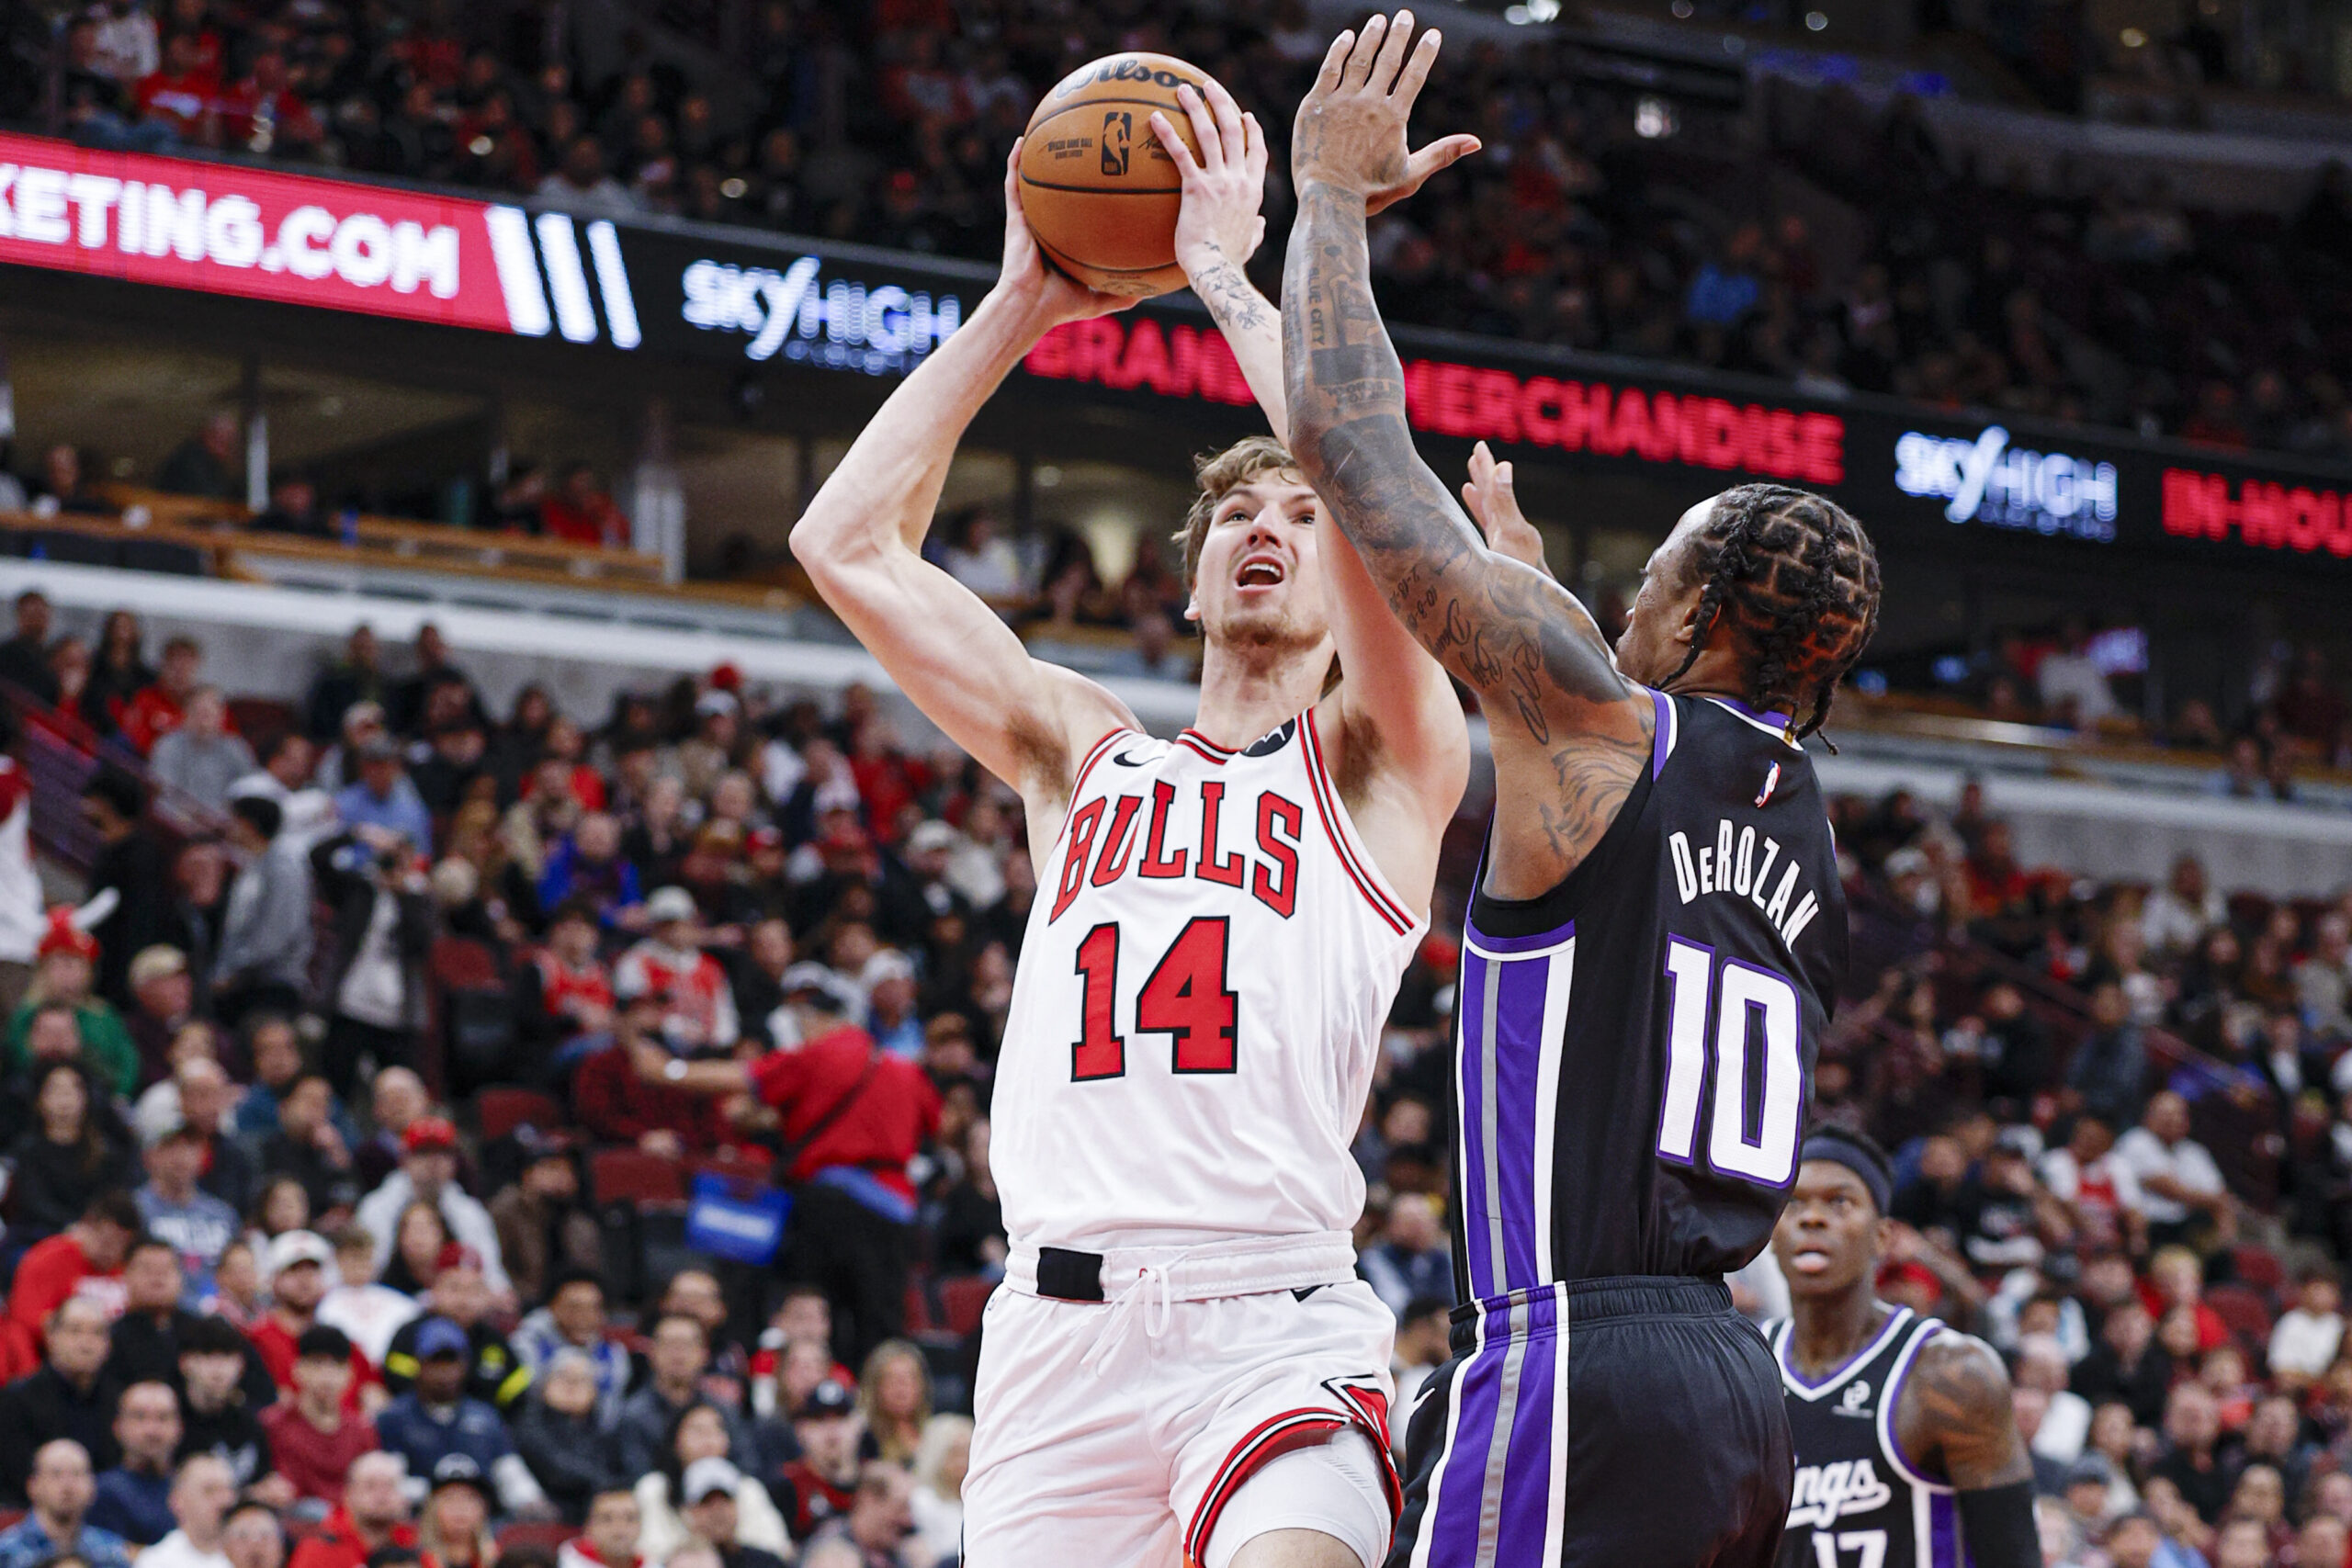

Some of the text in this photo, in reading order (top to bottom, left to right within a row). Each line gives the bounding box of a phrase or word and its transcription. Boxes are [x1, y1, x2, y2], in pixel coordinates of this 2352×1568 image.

[1048, 778, 1303, 920] BULLS
[1070, 915, 1238, 1082] 14
[1656, 931, 1805, 1190] 10
[1786, 1456, 1892, 1531] ngs
